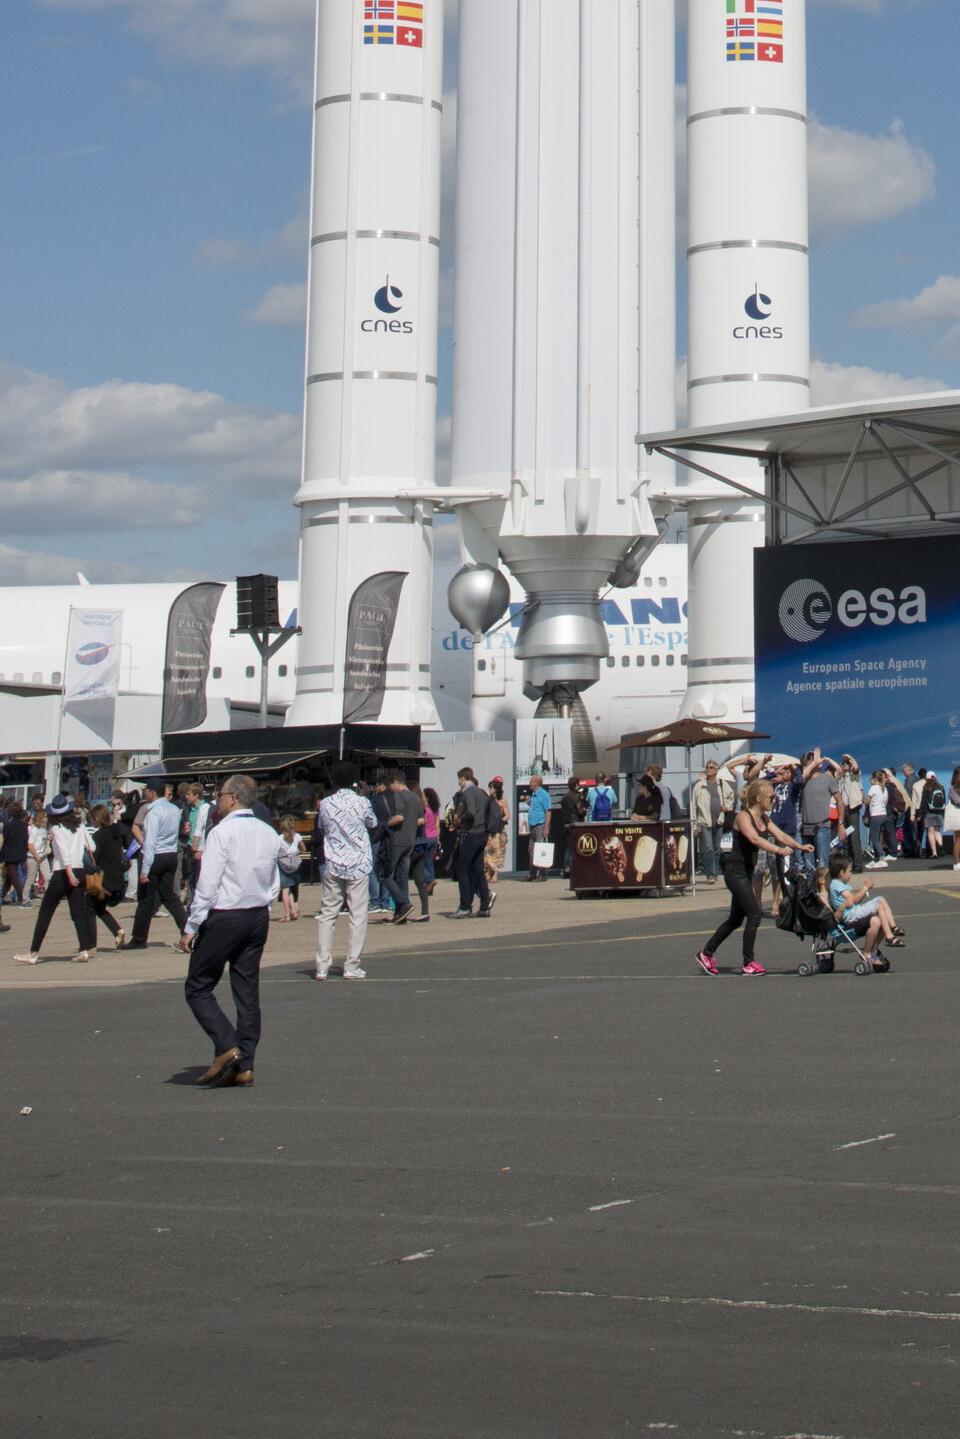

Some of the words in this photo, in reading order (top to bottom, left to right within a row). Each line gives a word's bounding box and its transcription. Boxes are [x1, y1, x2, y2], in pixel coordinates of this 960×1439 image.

[361, 319, 413, 334] cnes
[733, 326, 783, 339] cnes
[837, 585, 927, 627] esa
[360, 610, 385, 622] PAUL
[442, 630, 474, 651] de
[803, 662, 851, 675] European
[854, 659, 884, 673] Space
[888, 657, 926, 672] Agency
[786, 680, 822, 694] Agence
[825, 678, 865, 692] spatiale
[868, 675, 928, 690] européenne
[615, 827, 623, 835] EN
